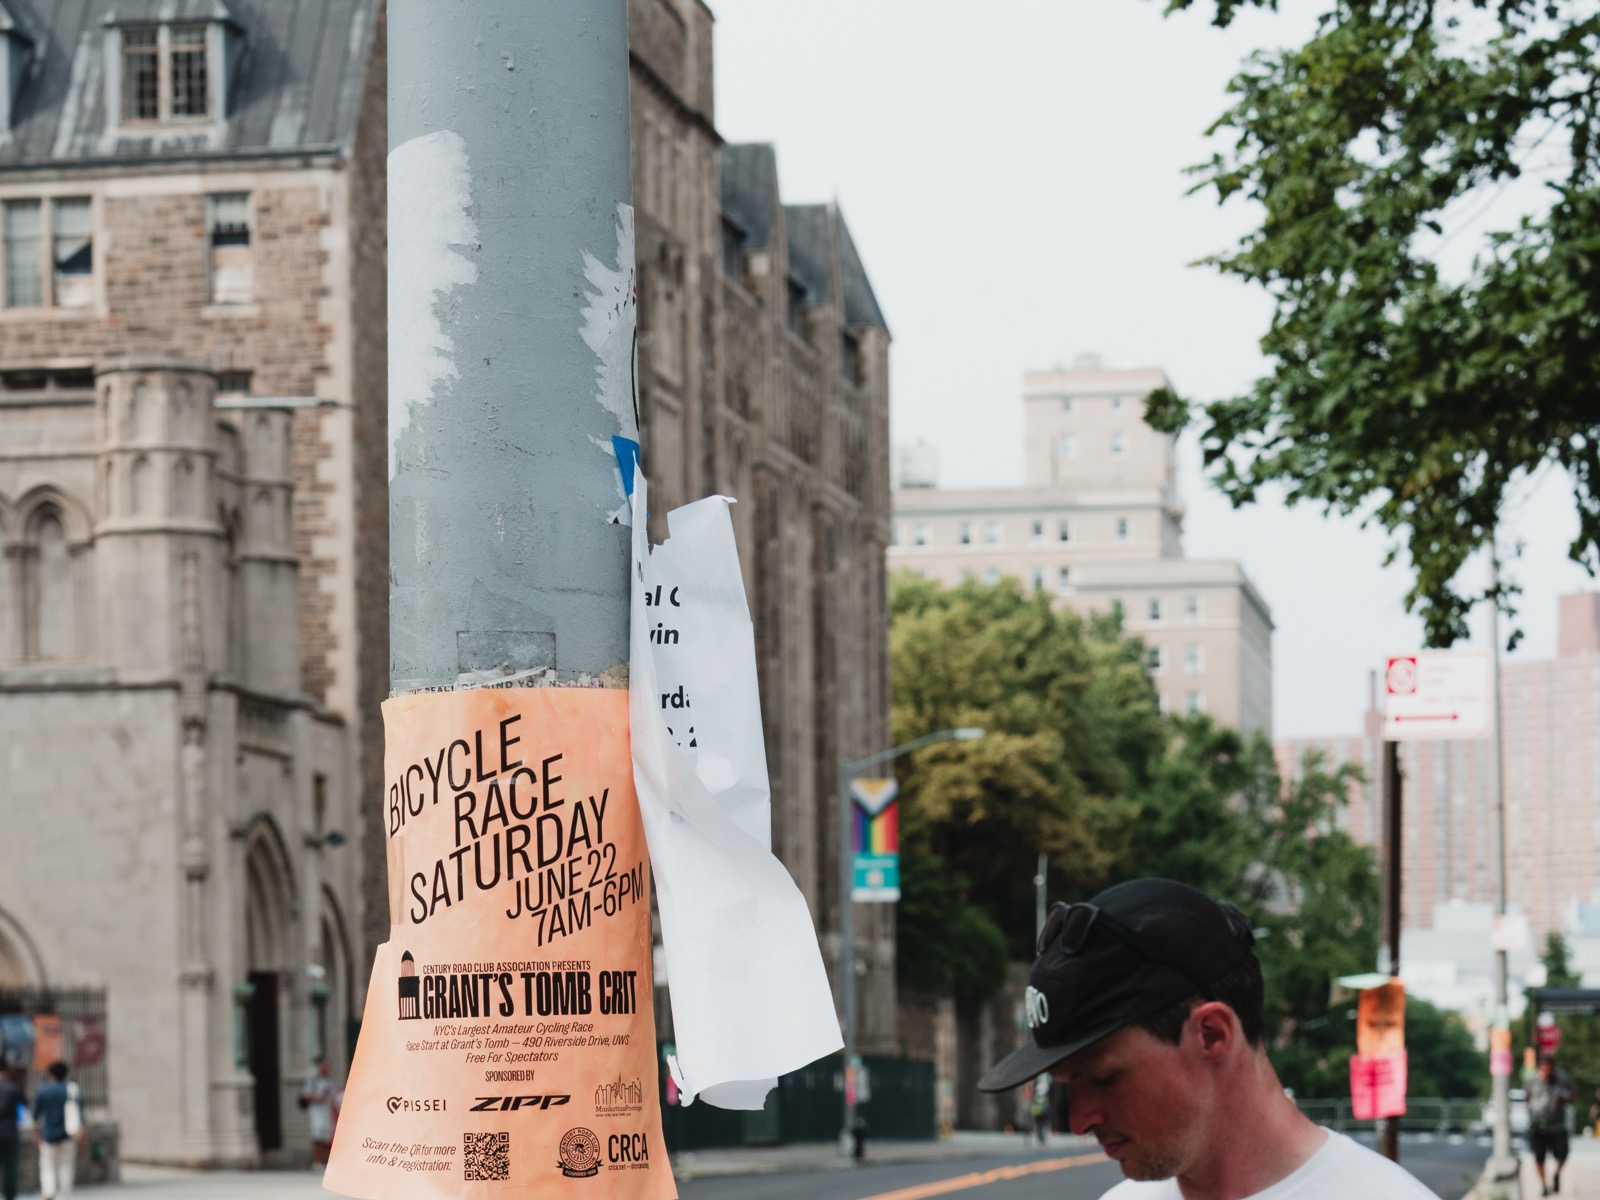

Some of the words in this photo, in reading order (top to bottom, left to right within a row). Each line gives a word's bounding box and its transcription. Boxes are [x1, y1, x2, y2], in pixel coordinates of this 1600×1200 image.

[390, 714, 522, 838] BICYCLE
[454, 753, 564, 847] RACE
[410, 788, 609, 924] SATURDAY
[506, 856, 583, 919] JUNE
[588, 842, 618, 888] 22
[531, 862, 643, 947] 7AM-6PM
[423, 964, 451, 974] CENTURY
[453, 963, 472, 973] ROAD
[474, 962, 494, 972] CLUB
[496, 961, 550, 972] ASSOCIATION
[552, 960, 591, 971] PRESENTS
[423, 973, 514, 1019] GRANT'S
[520, 971, 592, 1016] TOMB
[599, 970, 637, 1015] CRIT
[433, 1025, 457, 1036] NYC's
[458, 1024, 491, 1037] Largest
[492, 1023, 534, 1034] Amateur
[536, 1022, 571, 1035] Cycling
[571, 1022, 593, 1033] Race
[406, 1038, 420, 1051] Race
[421, 1039, 439, 1051] Start
[440, 1039, 449, 1050] at
[450, 1038, 483, 1050] Grant's
[484, 1037, 509, 1048] Tomb
[522, 1037, 543, 1047] 490
[543, 1036, 587, 1047] Riverside
[588, 1035, 610, 1047] Drive,
[612, 1034, 630, 1046] UWS
[465, 1052, 486, 1064] Free
[487, 1052, 502, 1063] For
[504, 1051, 559, 1064] Spectators
[485, 1070, 525, 1082] SPONSORED
[526, 1070, 535, 1081] BY
[403, 1099, 446, 1112] PISSEI
[469, 1095, 571, 1112] ZIPP
[362, 1137, 390, 1151] Scan
[390, 1142, 409, 1154] the
[410, 1143, 422, 1157] QR
[421, 1145, 432, 1156] for
[433, 1145, 456, 1156] more
[562, 1131, 576, 1153] CENTURY
[608, 1133, 649, 1163] CRCA
[366, 1153, 387, 1165] info
[387, 1157, 398, 1167] &
[397, 1160, 452, 1172] registration:
[564, 1157, 596, 1170] ASSOCIATION
